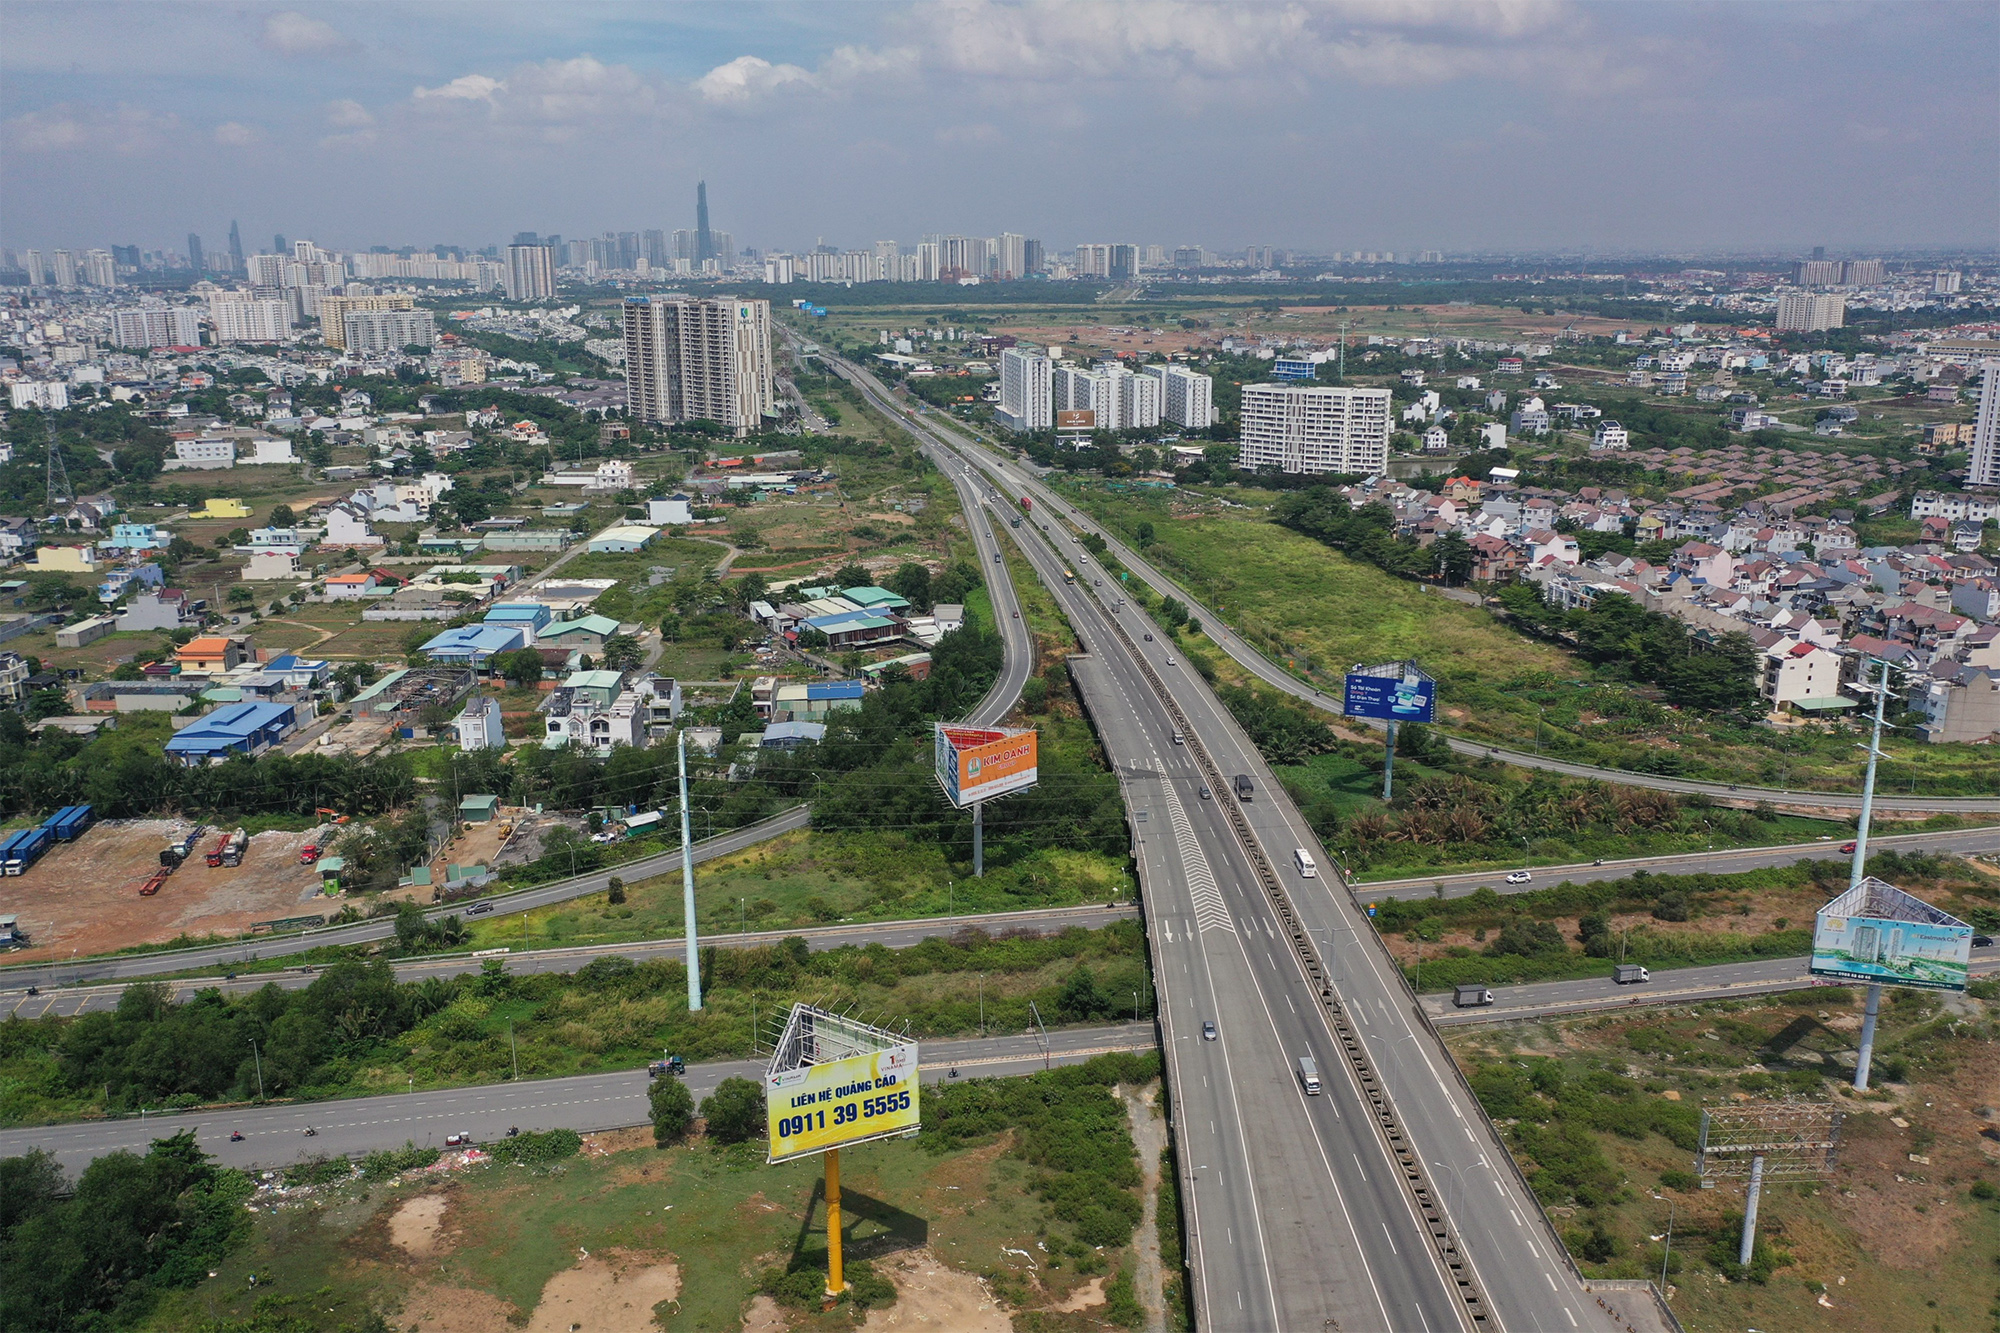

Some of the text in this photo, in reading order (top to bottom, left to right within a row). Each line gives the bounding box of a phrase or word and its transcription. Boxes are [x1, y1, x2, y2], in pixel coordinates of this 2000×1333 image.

[983, 745, 1030, 767] KIM OANH
[998, 760, 1017, 770] GROUP
[791, 1074, 897, 1108] LIÊN HỆ QUẢNG CÁO
[778, 1090, 910, 1138] 0911 39 5555
